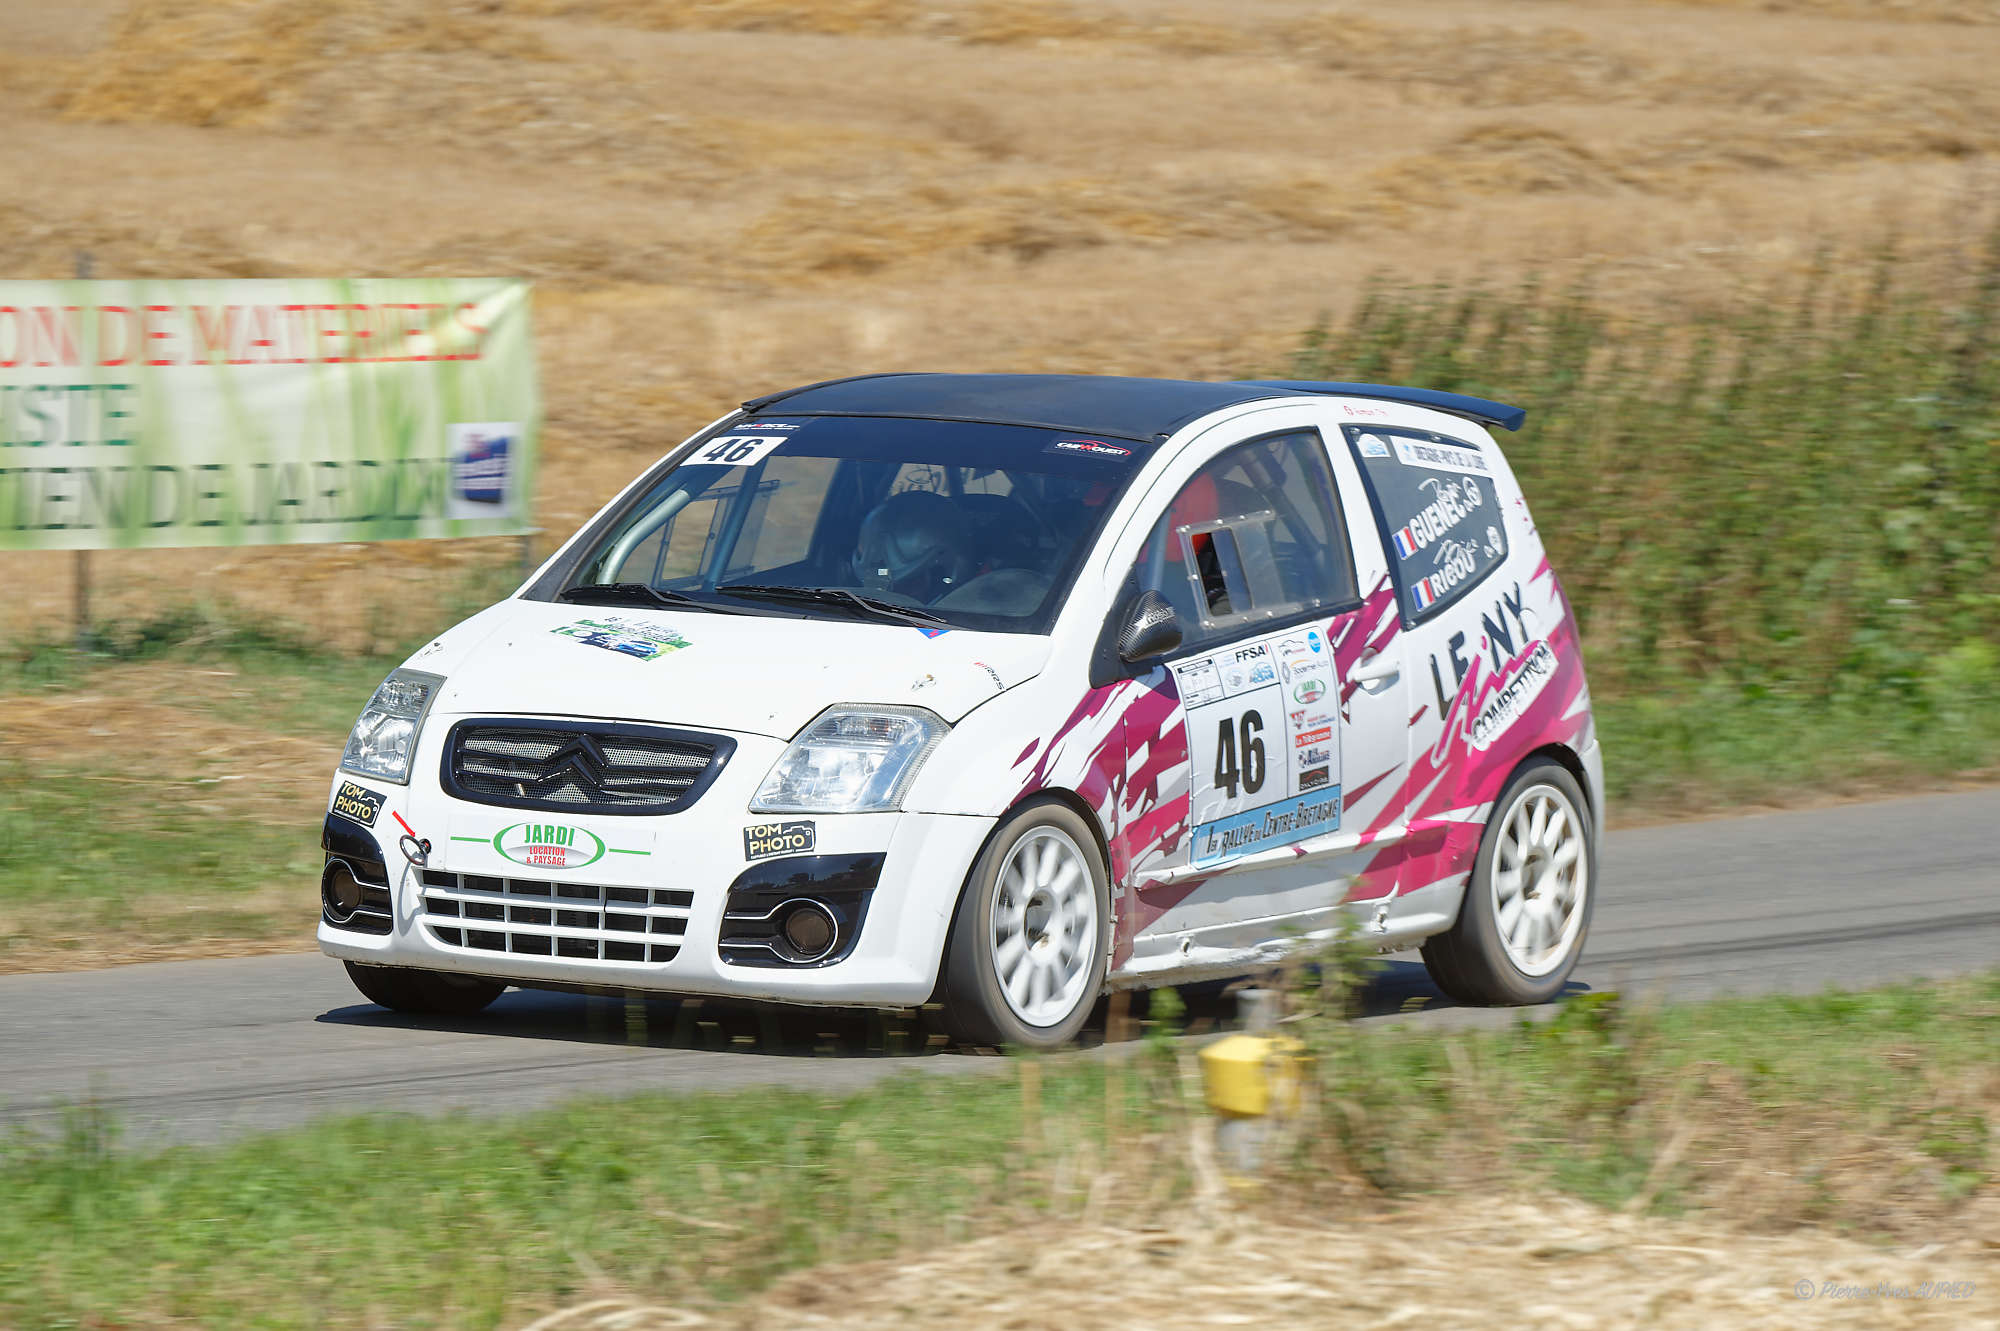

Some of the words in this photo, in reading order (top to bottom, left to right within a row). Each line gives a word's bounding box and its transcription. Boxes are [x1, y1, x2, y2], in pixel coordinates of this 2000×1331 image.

[96, 303, 178, 366] DE
[702, 438, 764, 462] 46
[141, 464, 229, 528] DE
[1235, 645, 1266, 663] FFSA
[1214, 709, 1266, 799] 46
[341, 782, 367, 800] TOM
[335, 796, 371, 819] PHOTO
[524, 824, 575, 847] JARDI
[746, 824, 782, 839] TOM
[1221, 823, 1255, 856] RALLYE
[1262, 799, 1338, 839] CENTRE-BRETAGNE
[529, 845, 566, 857] LOCATION
[749, 834, 805, 855] PHOTO
[533, 855, 566, 867] PAYSAGE
